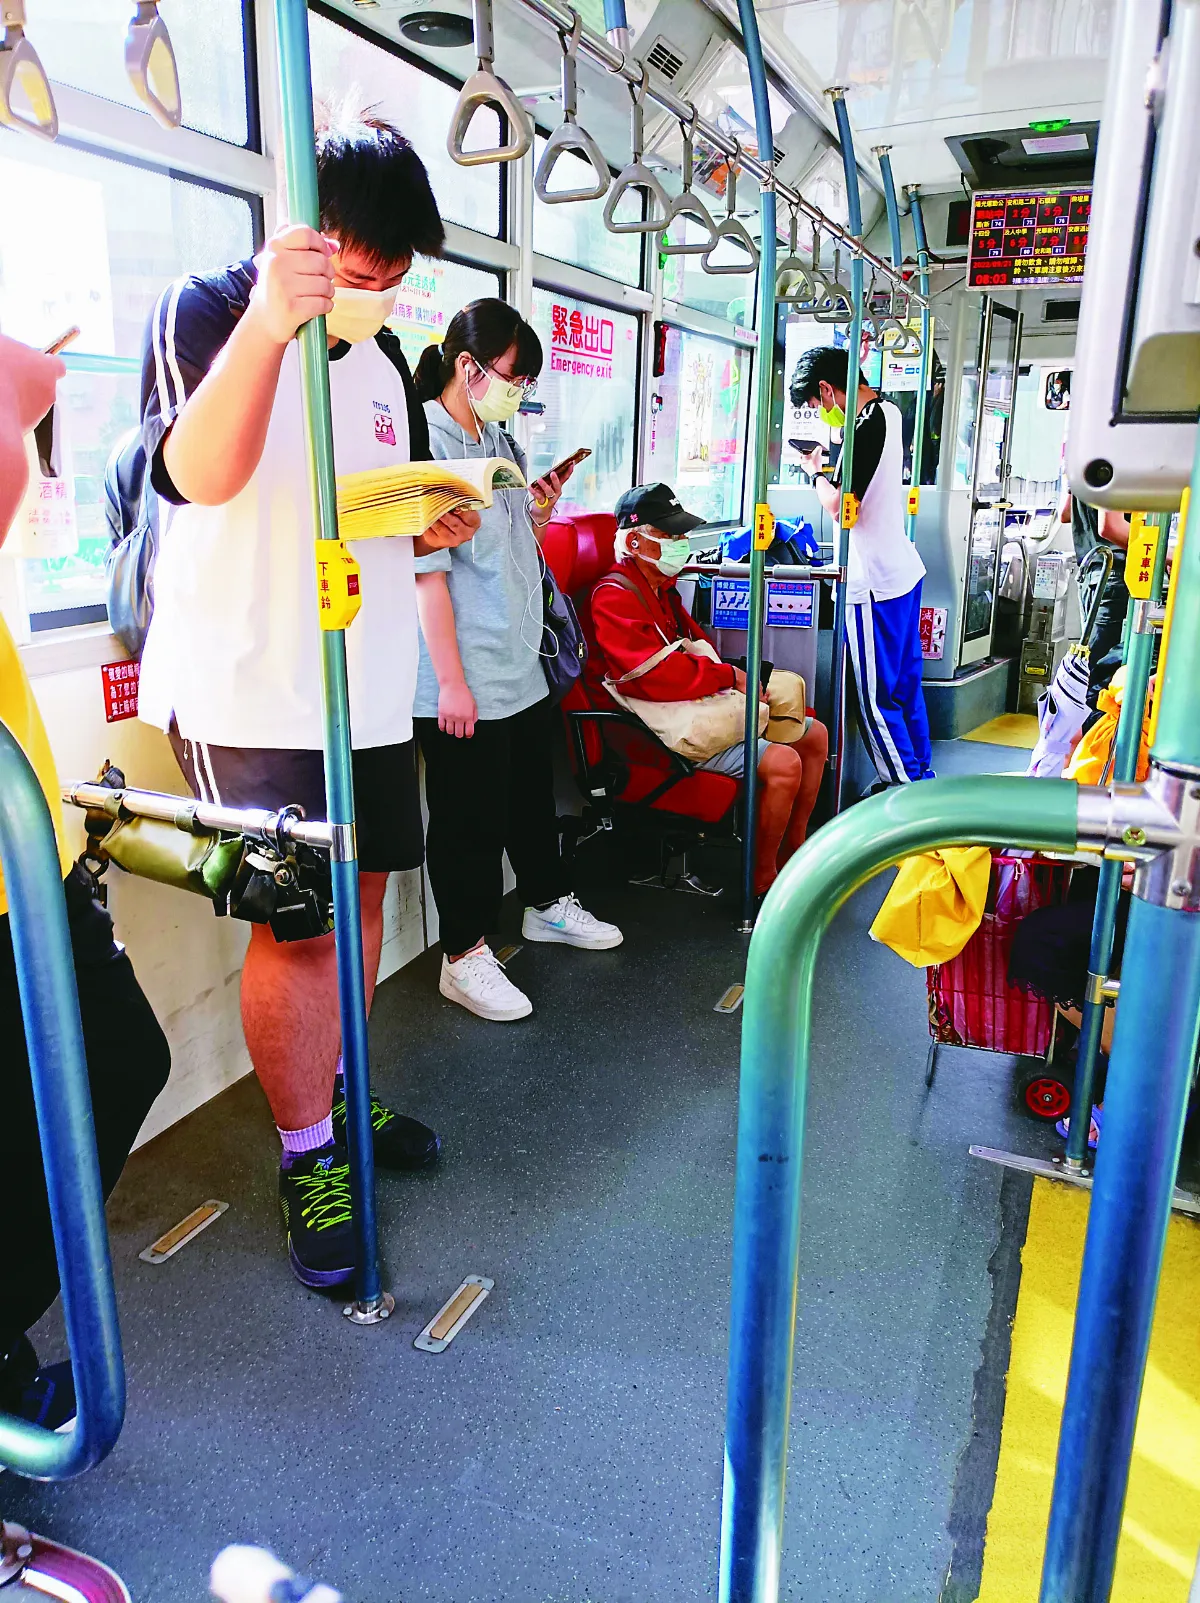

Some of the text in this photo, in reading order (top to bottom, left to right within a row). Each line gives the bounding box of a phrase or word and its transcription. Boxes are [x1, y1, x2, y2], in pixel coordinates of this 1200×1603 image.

[975, 273, 1007, 285] 08:03
[551, 304, 614, 355] 緊急出口
[551, 353, 612, 379] Emergency exit
[1138, 543, 1154, 583] 下車鈴
[318, 561, 331, 609] 下車鈴
[716, 581, 736, 590] 博愛座
[920, 609, 932, 651] 滅火器
[110, 681, 139, 699] 為了您的
